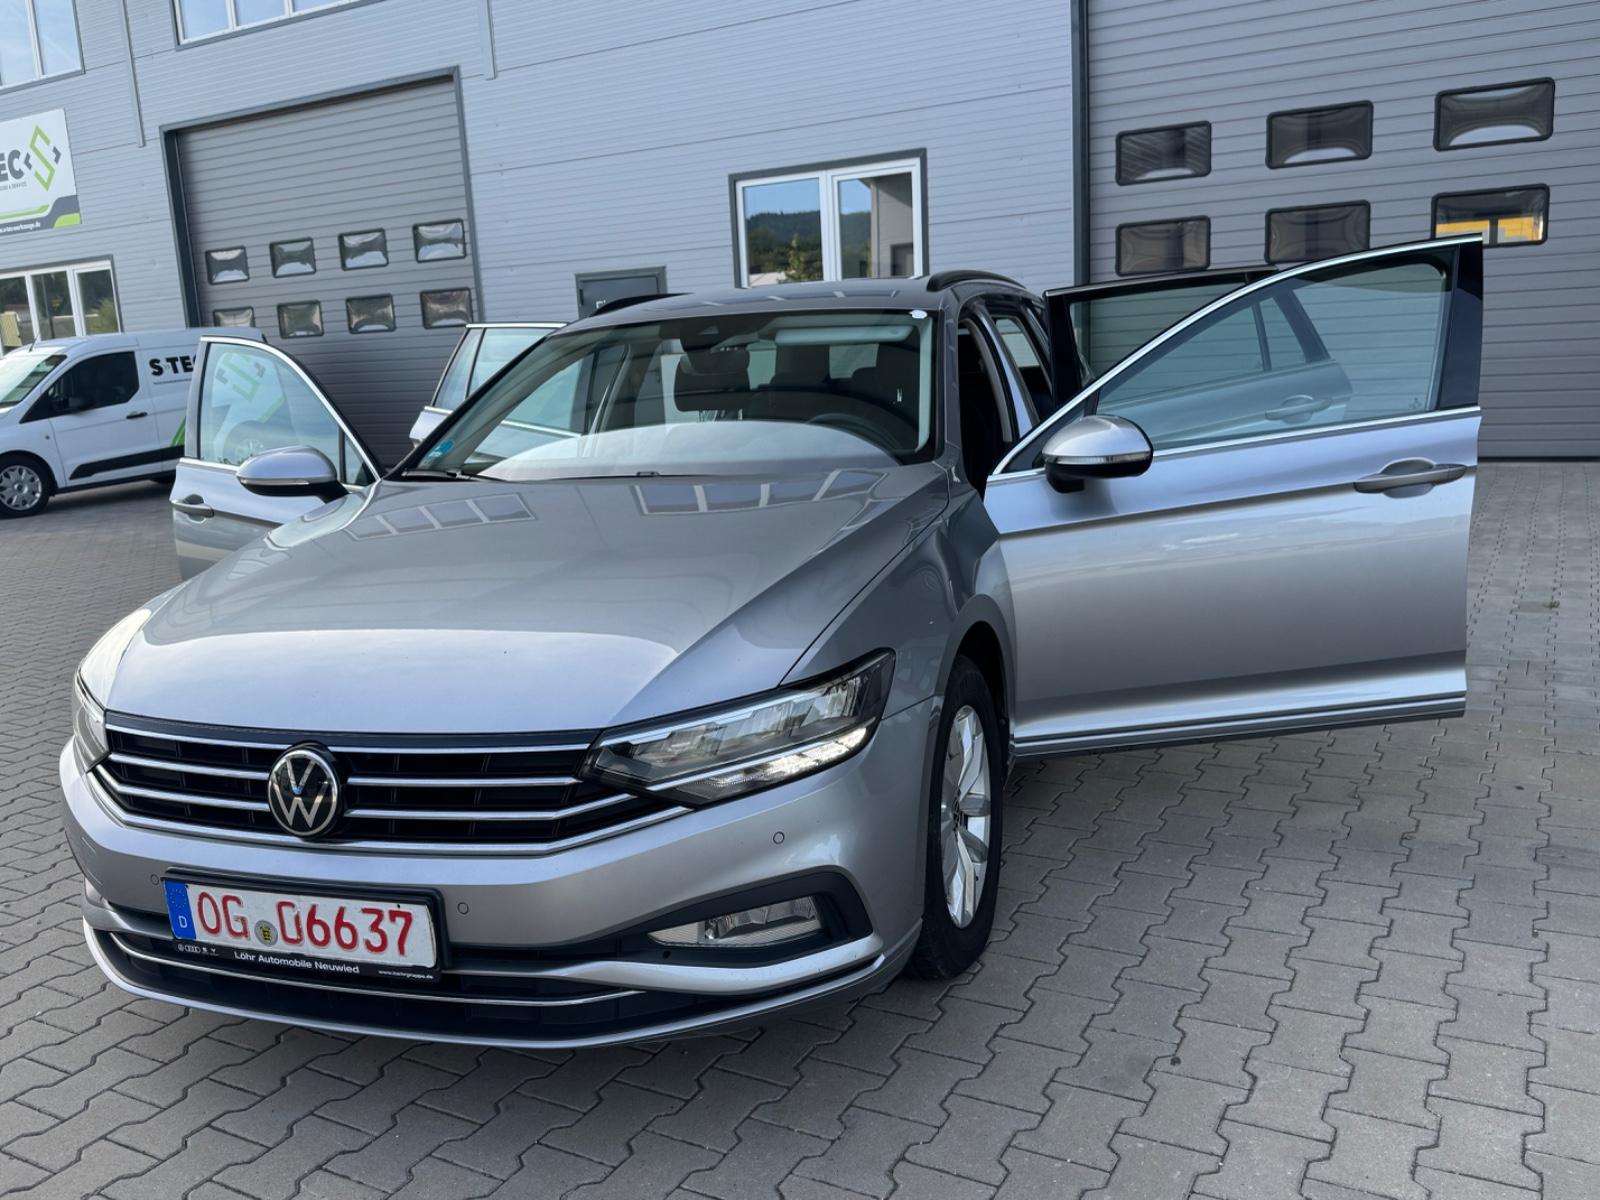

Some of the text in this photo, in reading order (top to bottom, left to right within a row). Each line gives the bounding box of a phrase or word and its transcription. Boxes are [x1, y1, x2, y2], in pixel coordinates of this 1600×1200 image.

[178, 915, 188, 929] D
[197, 891, 414, 956] OG 06637
[234, 950, 360, 974] Löhr Automobile Neuwied
